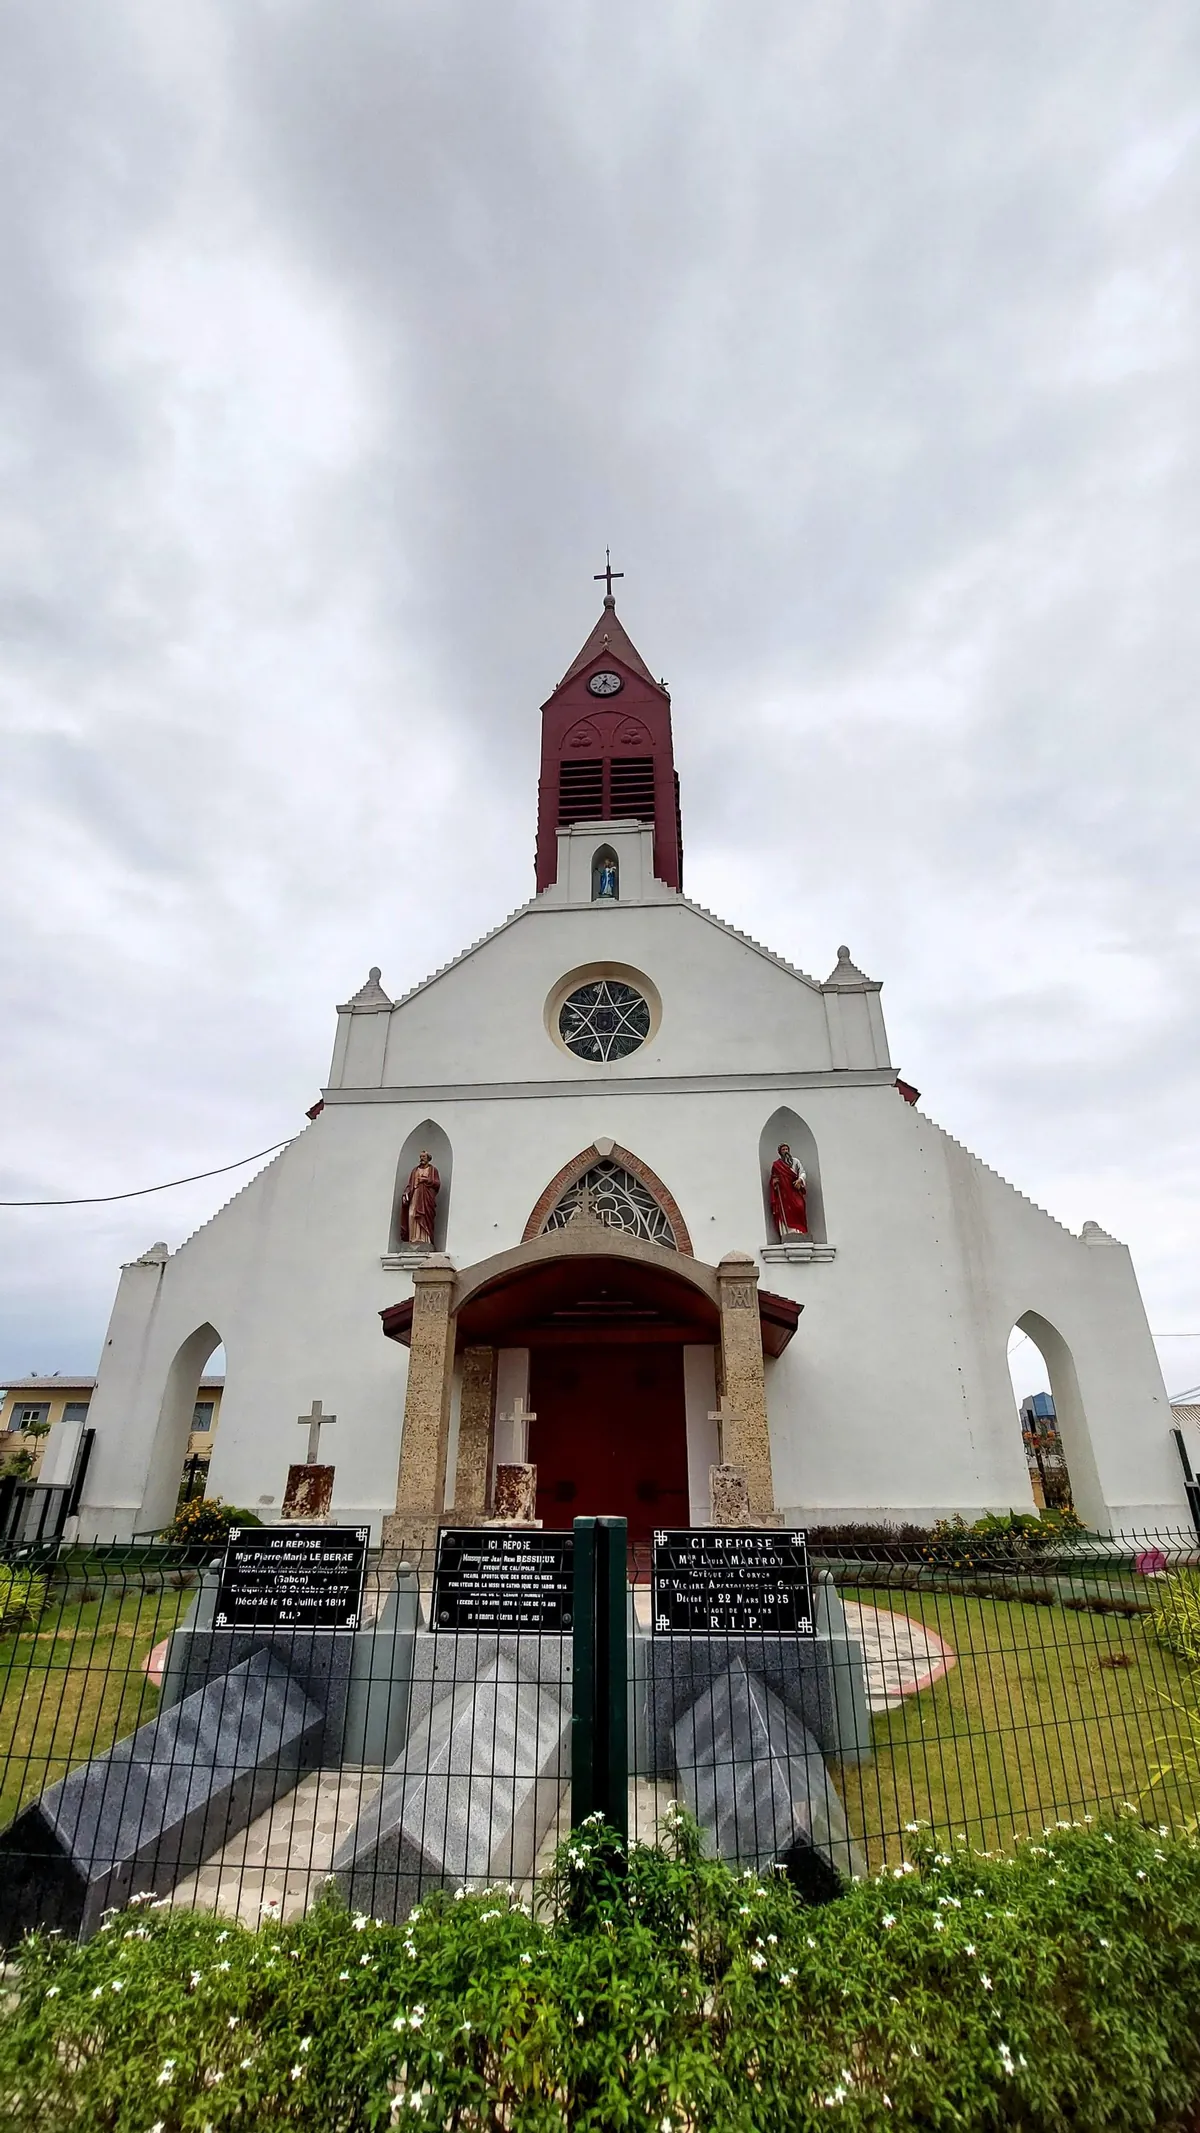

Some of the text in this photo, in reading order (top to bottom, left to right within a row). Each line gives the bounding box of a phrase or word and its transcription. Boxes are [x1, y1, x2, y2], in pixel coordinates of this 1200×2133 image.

[270, 1540, 322, 1549] ICI REPOSE
[488, 1540, 531, 1550] ICI REPOSE
[689, 1538, 705, 1549] CI
[235, 1552, 252, 1562] Mgr
[310, 1553, 322, 1561] LE
[323, 1553, 354, 1562] BERRE
[282, 1598, 293, 1606] 16
[718, 1593, 731, 1603] 22
[764, 1594, 790, 1604] 1925
